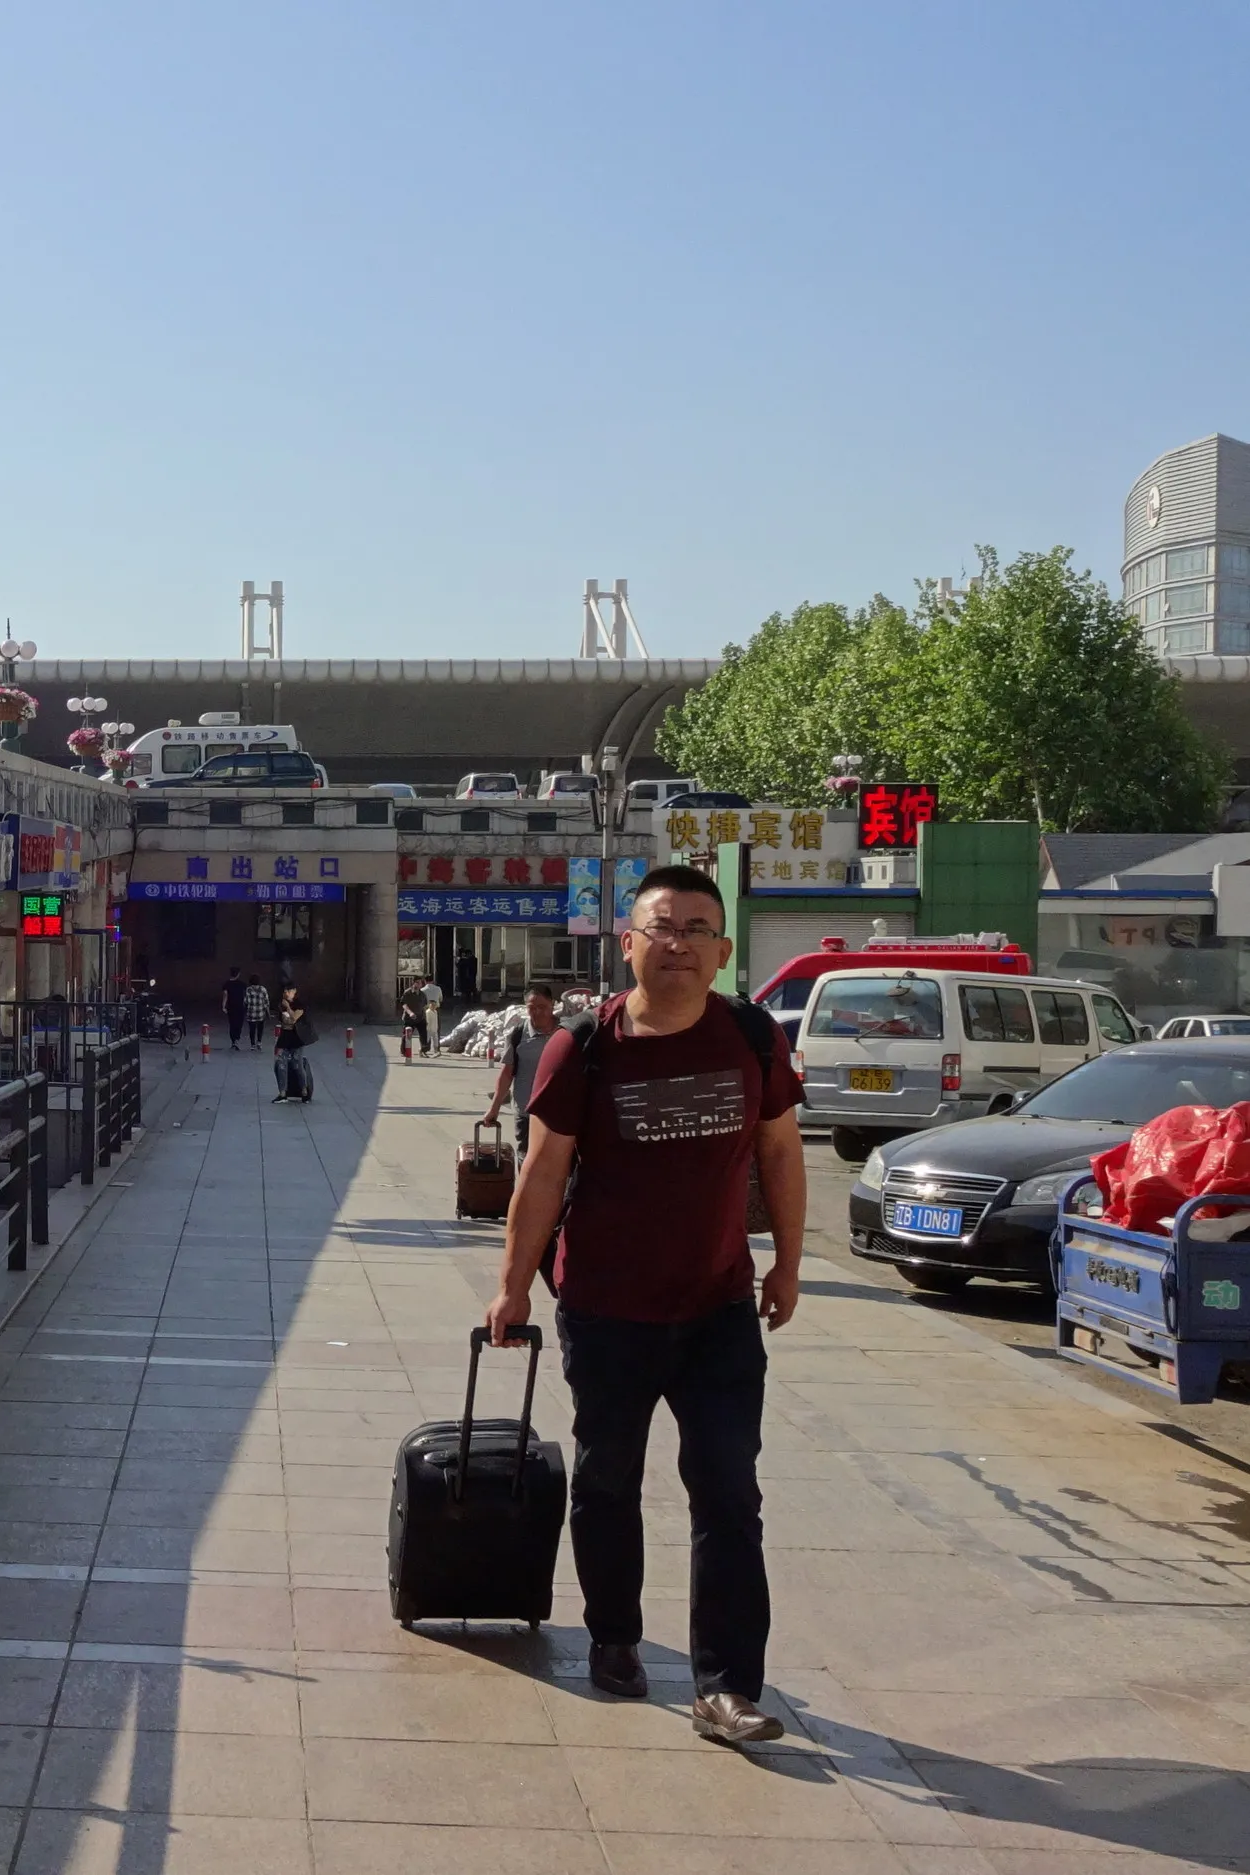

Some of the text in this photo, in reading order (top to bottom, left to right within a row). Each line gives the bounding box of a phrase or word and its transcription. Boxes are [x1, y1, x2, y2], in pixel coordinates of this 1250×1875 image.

[666, 809, 826, 851] 快捷宾馆
[863, 786, 935, 846] 宾馆
[186, 856, 339, 880] 南出站口
[852, 1078, 891, 1090] C6139
